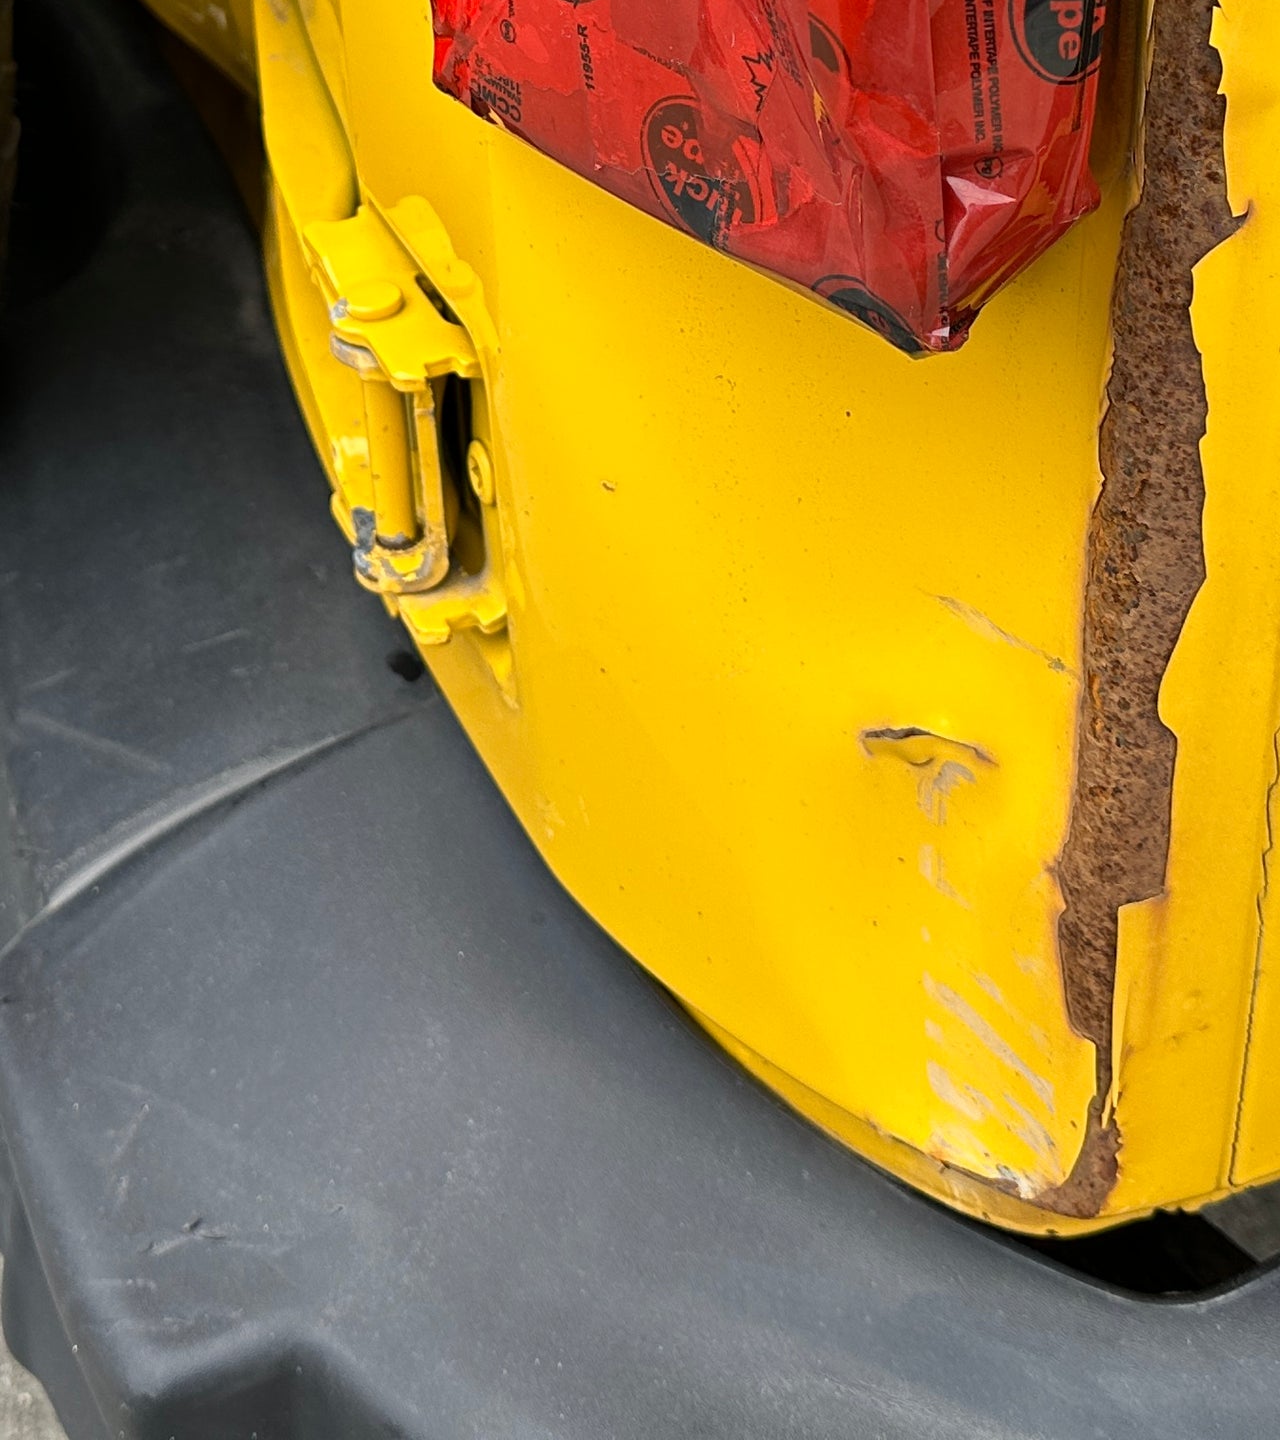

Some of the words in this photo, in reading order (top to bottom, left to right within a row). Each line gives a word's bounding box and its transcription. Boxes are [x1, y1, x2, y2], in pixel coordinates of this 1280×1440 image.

[577, 23, 595, 91] 11955-R
[981, 9, 1000, 75] INTERTAPE
[470, 78, 522, 123] CCMC
[970, 62, 986, 118] POLYMER
[989, 76, 1004, 132] POLYMER
[974, 120, 988, 144] INC.
